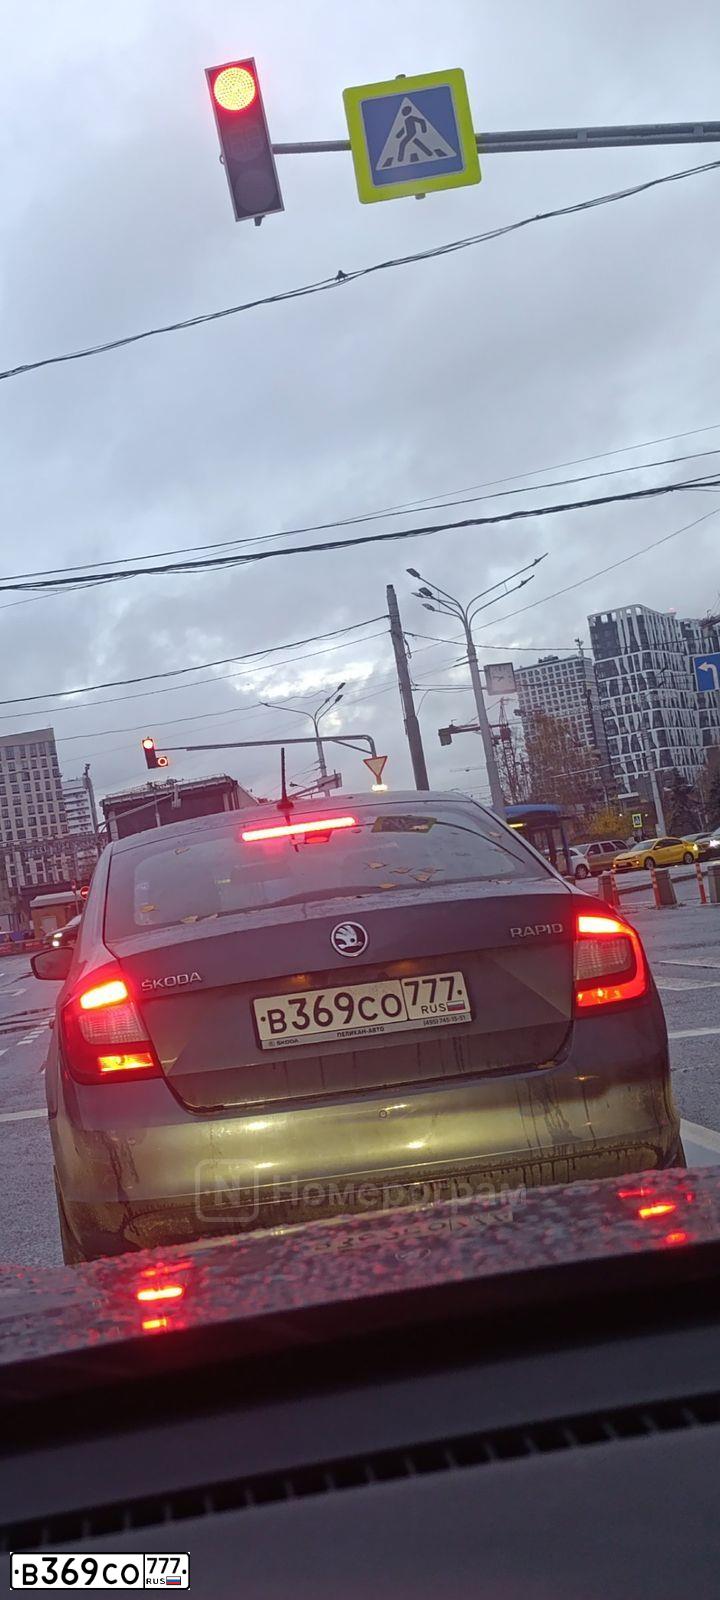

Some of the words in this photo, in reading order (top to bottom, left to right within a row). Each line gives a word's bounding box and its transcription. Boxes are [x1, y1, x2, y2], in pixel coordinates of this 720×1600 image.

[510, 923, 563, 938] RAPID
[404, 976, 455, 1006] 777
[421, 1002, 446, 1015] RUS
